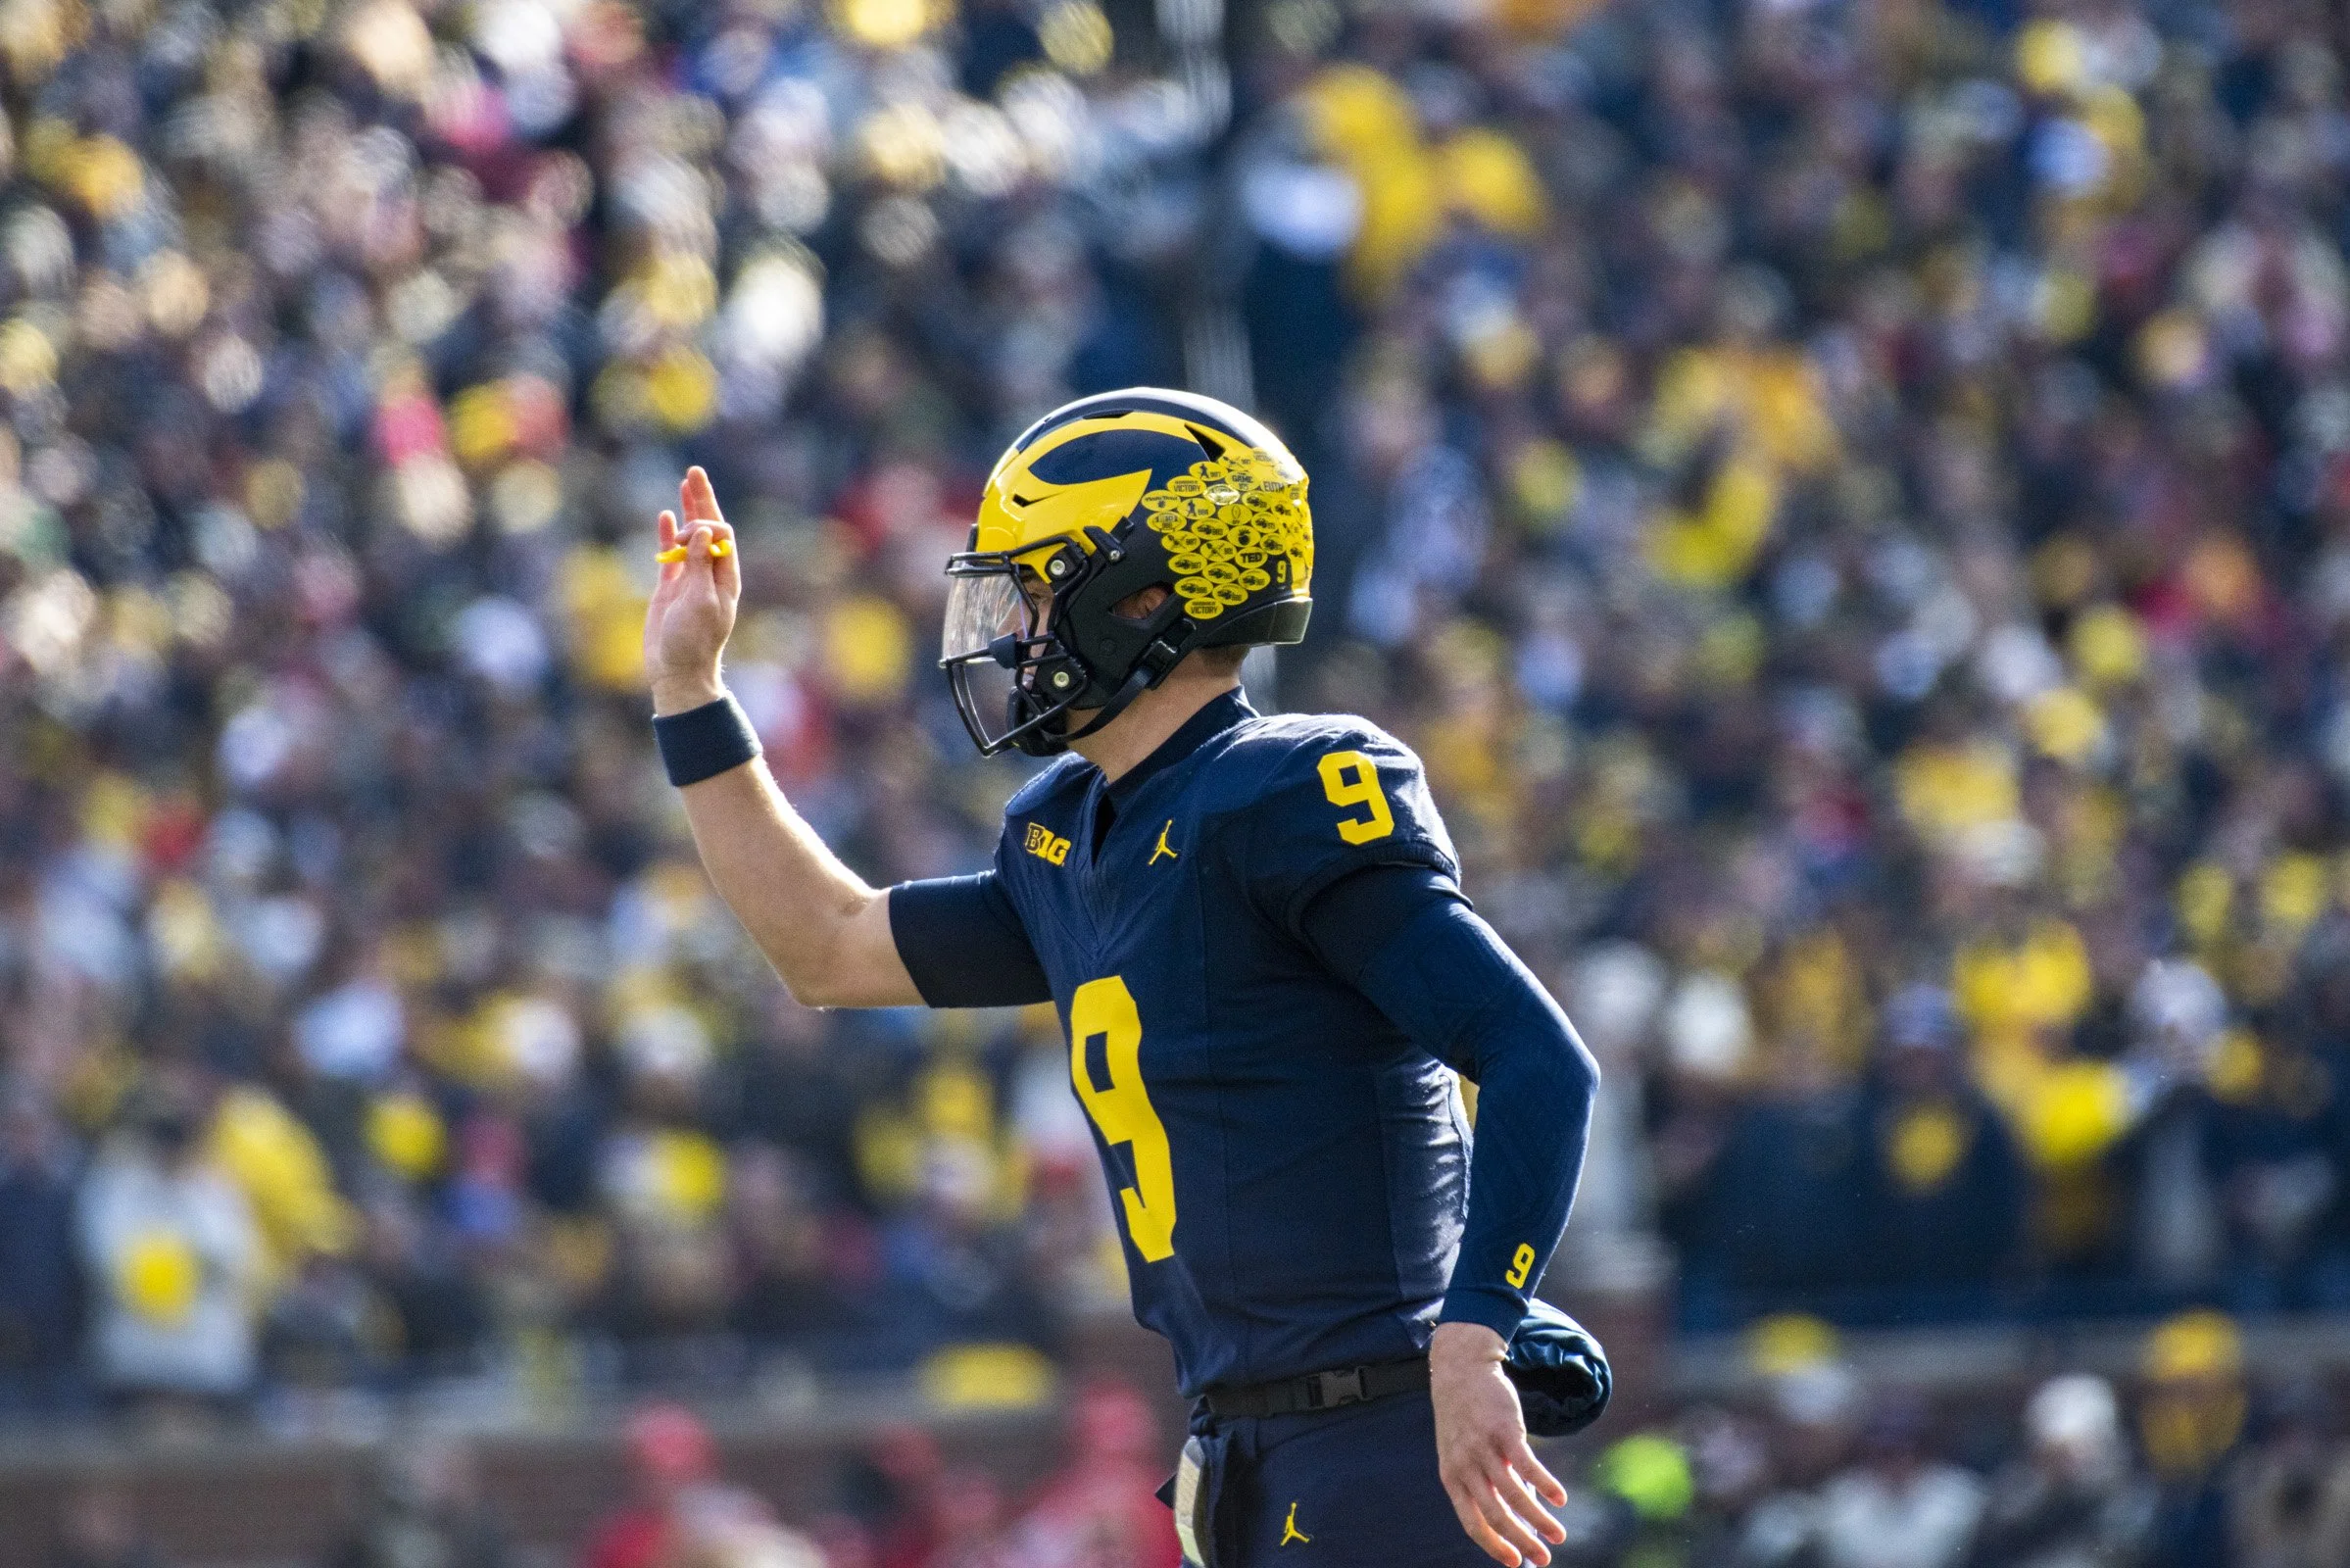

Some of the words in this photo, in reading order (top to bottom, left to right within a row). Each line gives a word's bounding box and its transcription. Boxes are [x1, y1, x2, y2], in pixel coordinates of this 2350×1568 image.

[1232, 474, 1253, 483] GAME
[1240, 552, 1263, 564] TED
[1277, 560, 1287, 583] 9
[1191, 606, 1217, 614] VICTORY
[1317, 750, 1395, 846] 9
[1070, 975, 1177, 1262] 9
[1505, 1243, 1536, 1289] 9
